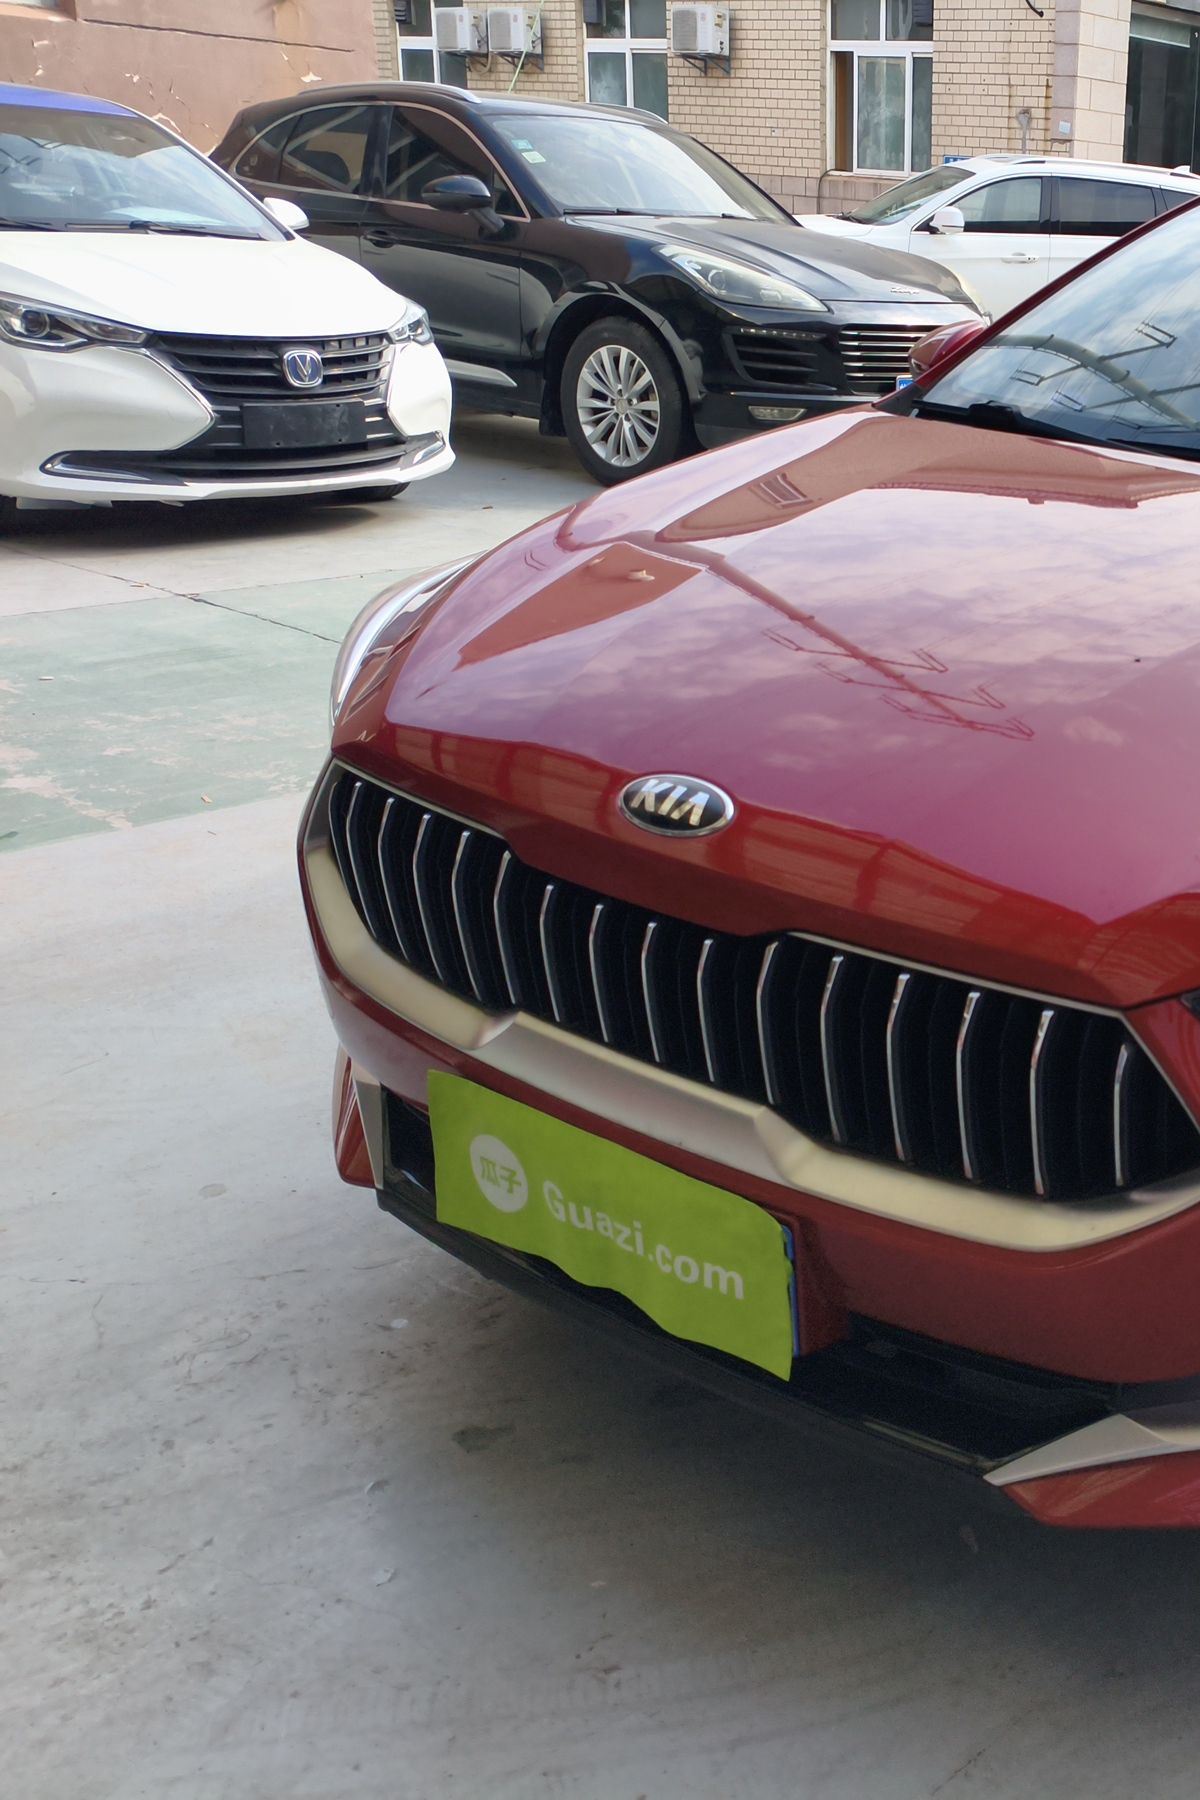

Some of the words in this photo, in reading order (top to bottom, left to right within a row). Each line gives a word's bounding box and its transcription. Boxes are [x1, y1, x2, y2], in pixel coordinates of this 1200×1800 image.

[630, 778, 710, 826] KIA
[480, 1155, 522, 1195] 瓜子
[542, 1180, 745, 1299] Guazi.com
